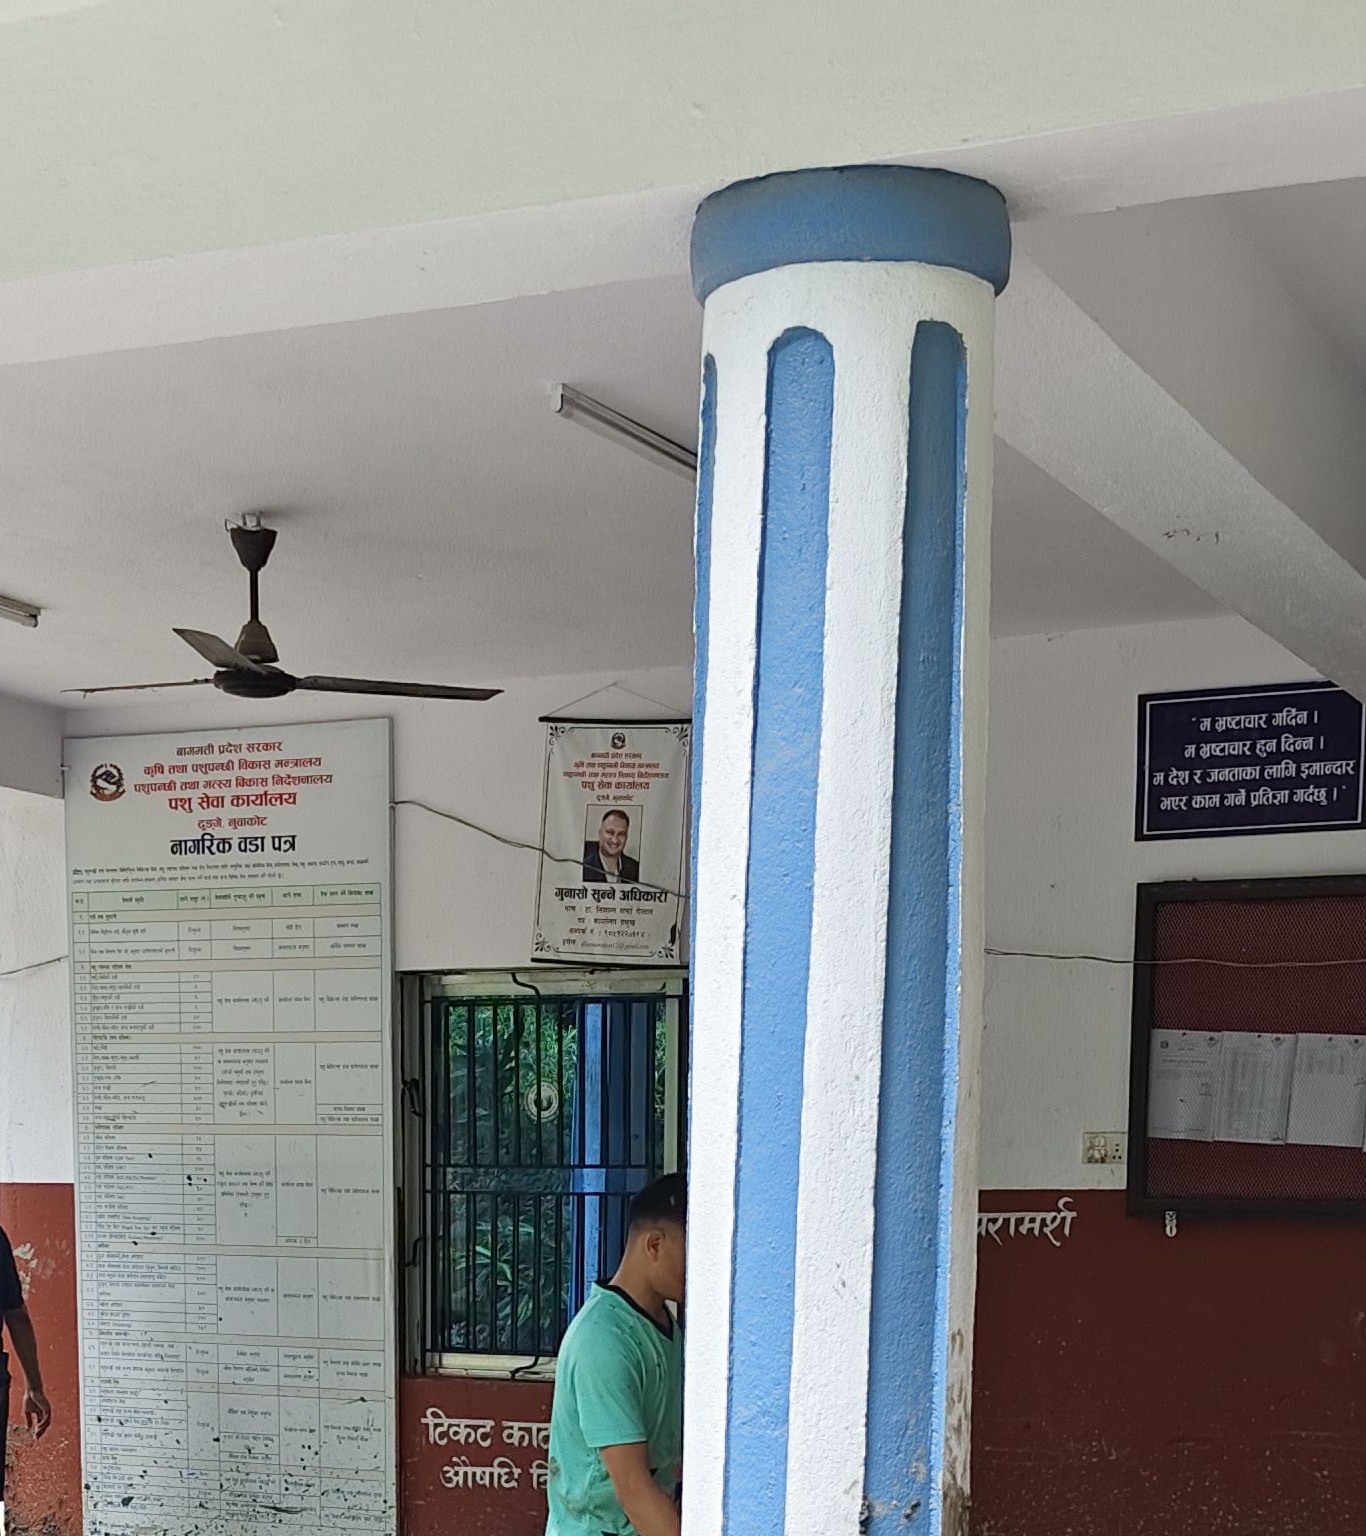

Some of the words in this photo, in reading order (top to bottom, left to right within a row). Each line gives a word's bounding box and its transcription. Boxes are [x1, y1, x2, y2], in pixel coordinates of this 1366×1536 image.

[1215, 713, 1267, 732] भ्रष्टाचार
[1272, 707, 1308, 727] गर्दिन
[177, 743, 214, 756] बागमती
[219, 742, 243, 755] प्रदेश
[246, 742, 283, 753] सरकार
[1184, 744, 1195, 758] म
[1199, 741, 1252, 759] भ्रष्टाचार
[1255, 739, 1276, 757] हुन
[1281, 735, 1314, 752] दिन्न
[144, 763, 164, 777] कृषि
[169, 764, 187, 775] तथा
[239, 759, 270, 770] विकास
[275, 757, 322, 769] मन्त्रालय
[1153, 772, 1164, 786] म
[1169, 767, 1188, 786] देश
[1193, 770, 1203, 783] र
[1206, 766, 1260, 783] जनताका
[1264, 761, 1296, 779] लागि
[1301, 760, 1356, 777] इमान्दार
[180, 781, 199, 791] तथा
[203, 779, 231, 790] मत्स्य
[236, 776, 268, 788] विकास
[615, 780, 650, 790] कार्यालय
[169, 797, 193, 813] पशु
[198, 793, 225, 809] सेवा
[231, 790, 297, 807] कार्यालय
[1160, 798, 1187, 811] भएर
[1192, 795, 1219, 808] काम
[1224, 789, 1246, 807] गर्ने
[1250, 787, 1289, 806] प्रतिज्ञा
[1293, 786, 1327, 805] गर्दछु
[229, 815, 268, 829] नुवाकोट
[170, 833, 233, 855] नागरिक
[238, 836, 265, 852] वडा
[271, 835, 296, 854] पत्र
[554, 885, 588, 902] गुनासो
[591, 887, 615, 903] सुन्ने
[619, 888, 667, 903] अधिकारी
[421, 1408, 494, 1448] टिकट
[440, 1456, 522, 1489] औषधि
